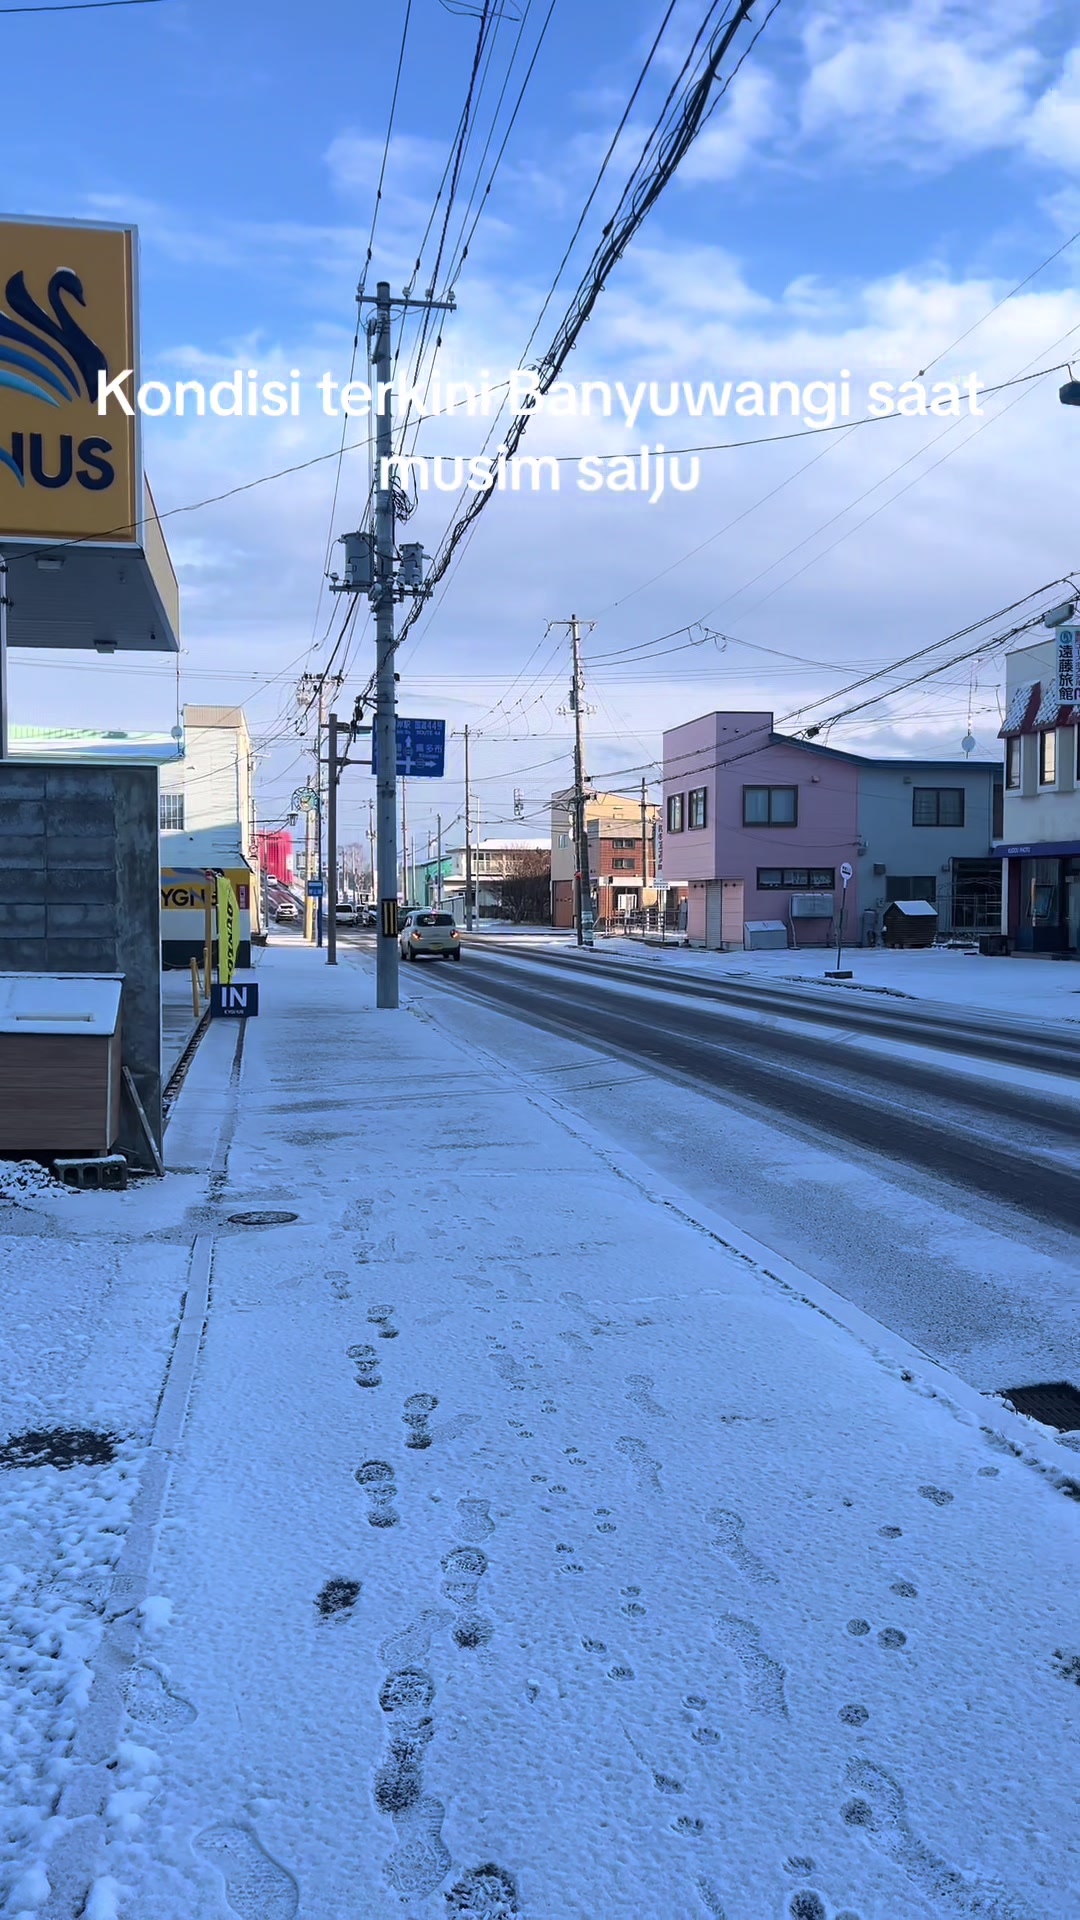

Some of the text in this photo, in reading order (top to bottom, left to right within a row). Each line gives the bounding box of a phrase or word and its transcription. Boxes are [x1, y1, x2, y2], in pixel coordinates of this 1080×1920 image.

[1058, 644, 1074, 701] 遠藤旅館
[221, 986, 248, 1008] IN
